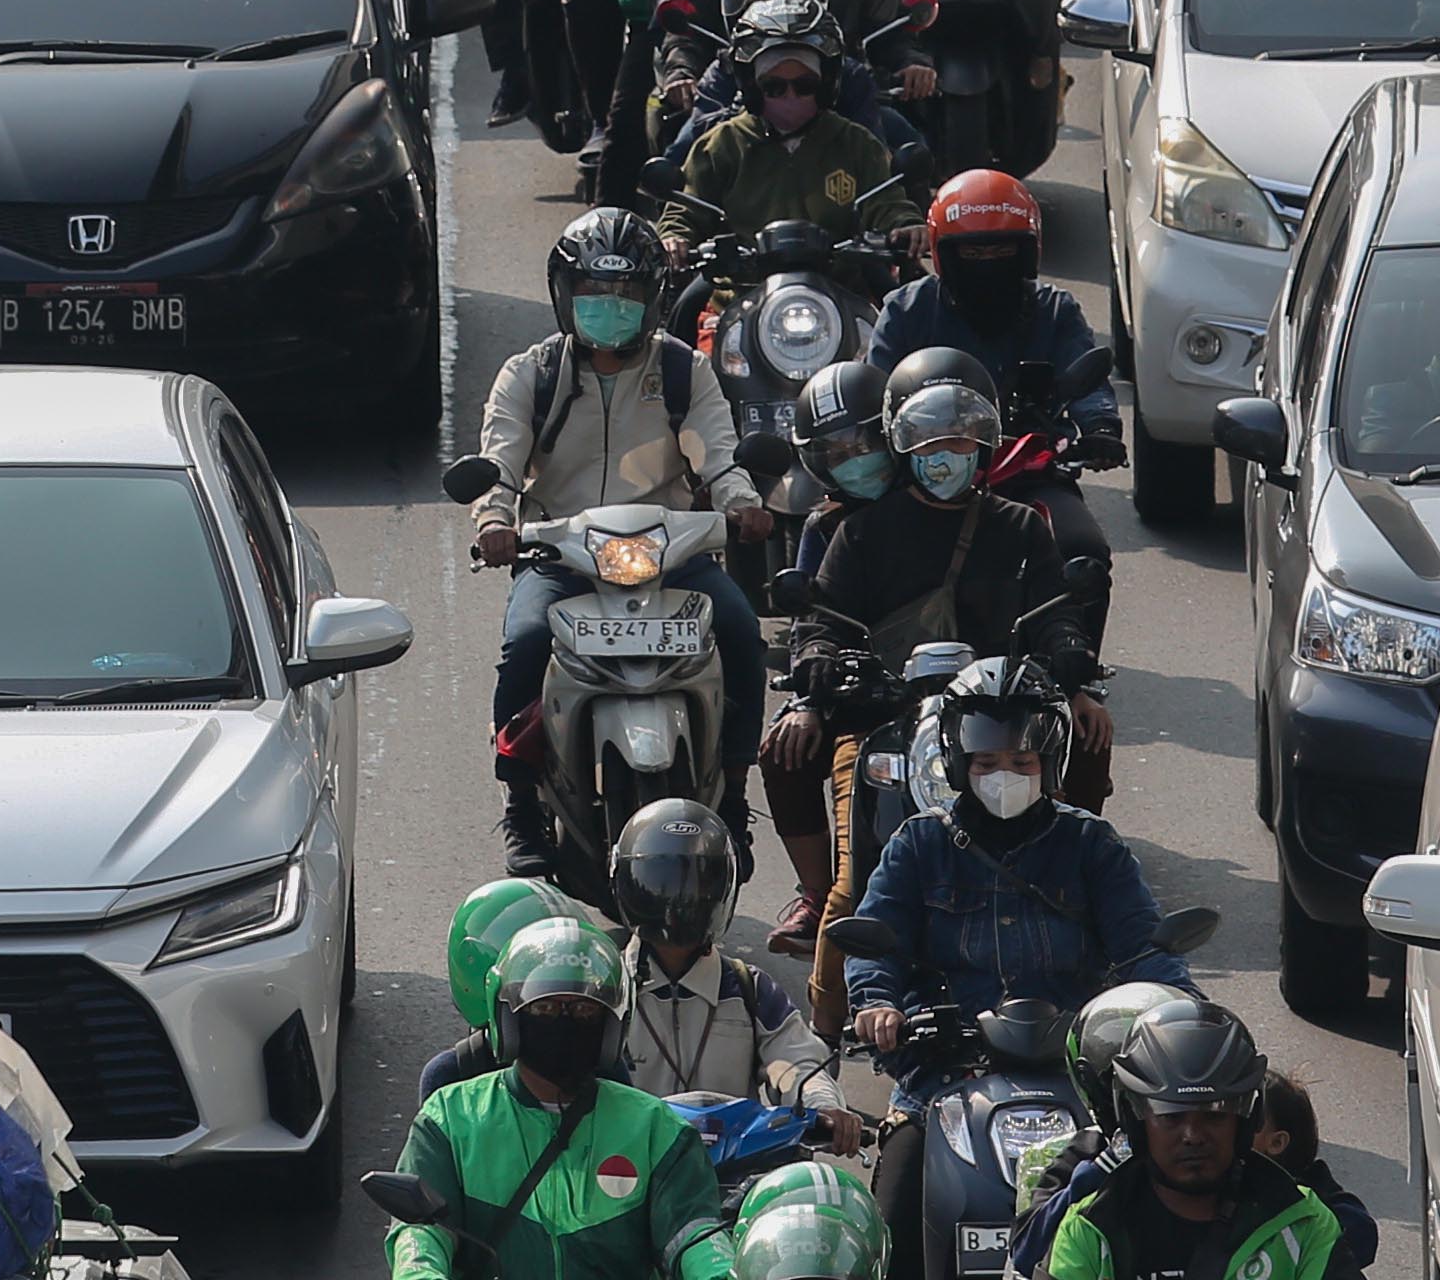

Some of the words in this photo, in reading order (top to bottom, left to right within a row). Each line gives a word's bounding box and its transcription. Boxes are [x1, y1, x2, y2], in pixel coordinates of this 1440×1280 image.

[960, 203, 1028, 217] ShopeeFood
[3, 299, 18, 330] B
[44, 300, 106, 331] 1254
[132, 298, 185, 329] BMB
[749, 407, 758, 422] B
[576, 621, 589, 636] B
[599, 621, 649, 638] 6247
[661, 621, 698, 638] ETR
[647, 642, 698, 654] 10-28
[544, 951, 592, 969] Grab
[967, 1231, 980, 1250] B
